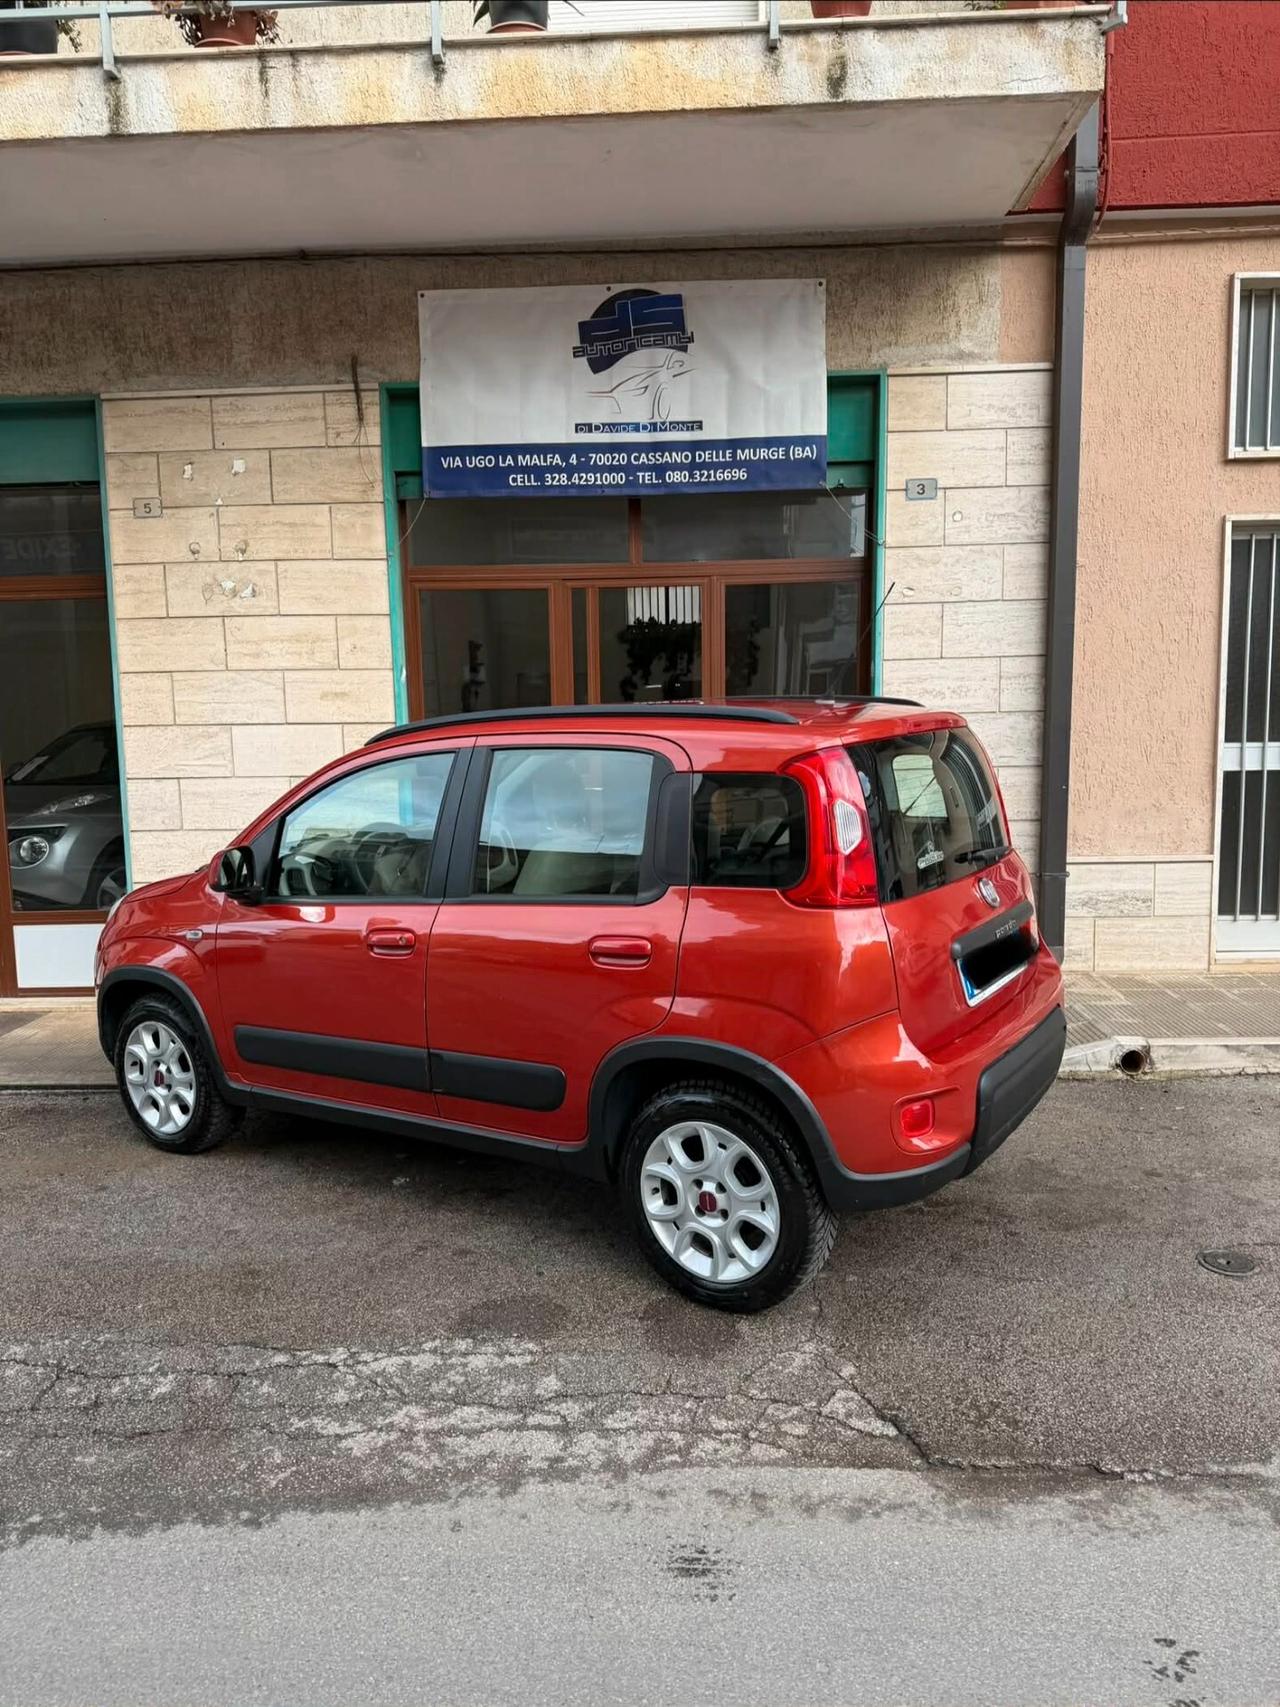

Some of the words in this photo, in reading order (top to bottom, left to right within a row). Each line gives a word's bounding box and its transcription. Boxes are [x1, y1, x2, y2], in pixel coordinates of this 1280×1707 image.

[592, 422, 636, 433] DAVIDE
[656, 420, 702, 432] MONTE
[441, 456, 463, 469] VIA
[466, 455, 495, 468] UGO
[499, 454, 515, 467] LA
[518, 453, 566, 468] MALFA,
[569, 454, 577, 466] 4
[589, 453, 628, 466] 70020
[631, 451, 692, 465] CASSANO
[695, 449, 733, 463] DELLE
[736, 447, 786, 461] MURGE
[789, 445, 817, 461] (BA)
[509, 474, 541, 487] CELL.
[544, 472, 626, 486] 328.4291000
[637, 471, 662, 484] TEL.
[665, 468, 748, 483] 080.3216696
[916, 483, 926, 495] 3
[143, 502, 152, 514] 5
